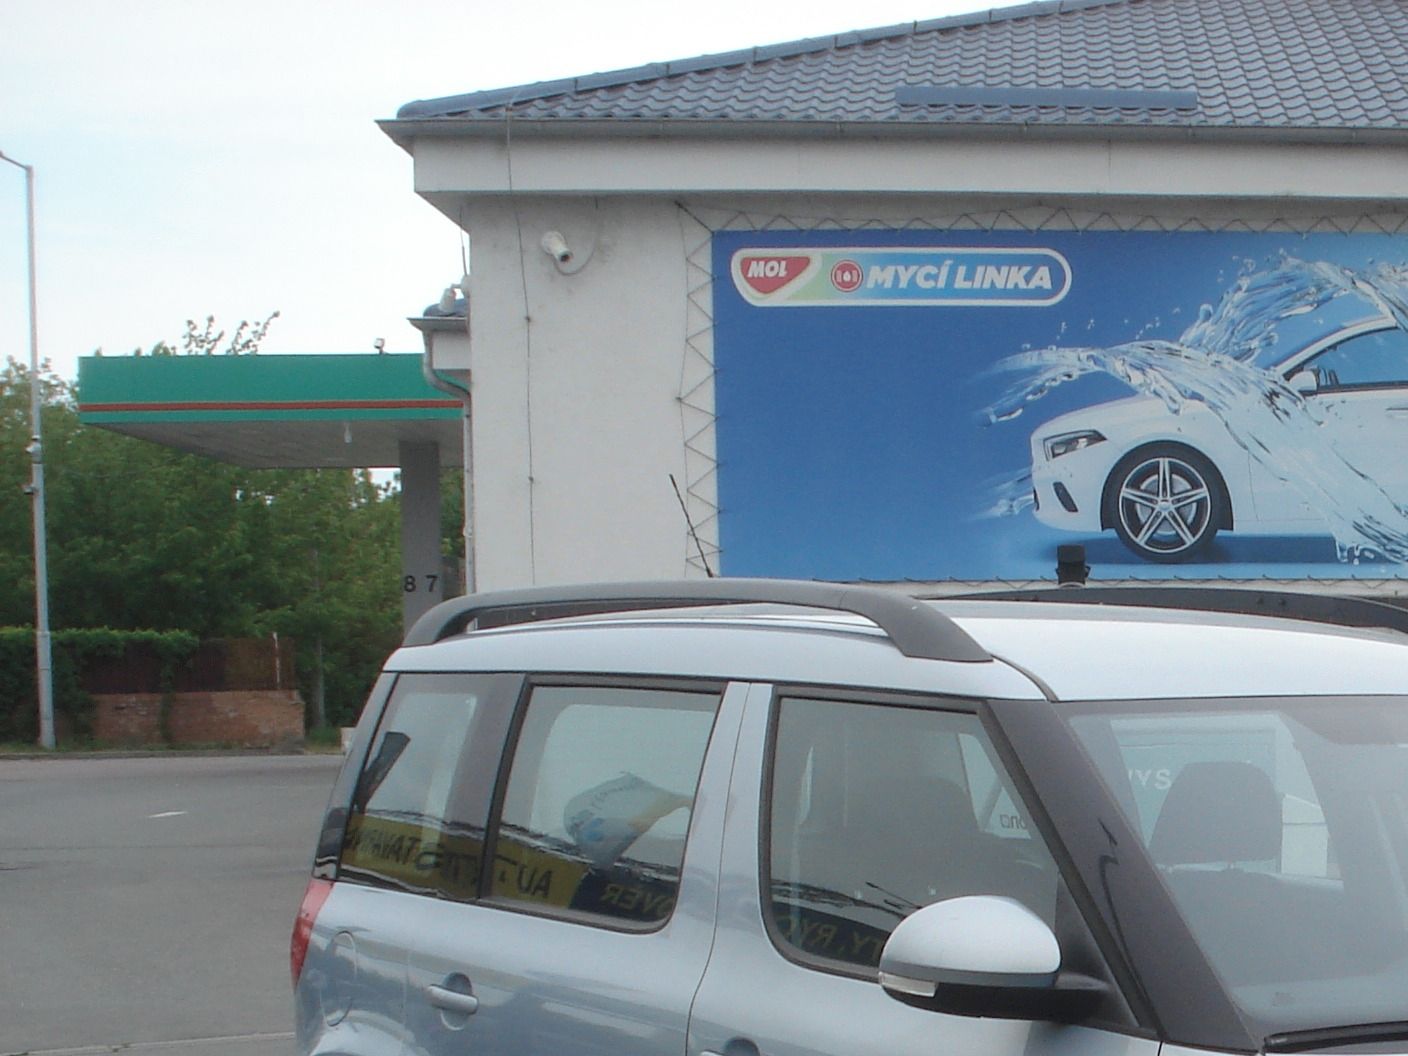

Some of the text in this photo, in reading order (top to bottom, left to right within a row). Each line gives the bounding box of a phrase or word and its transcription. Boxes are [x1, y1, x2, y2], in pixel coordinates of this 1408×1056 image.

[747, 260, 788, 279] MOL
[867, 260, 1053, 290] MYCÍ LINKA
[404, 575, 439, 593] 8 7
